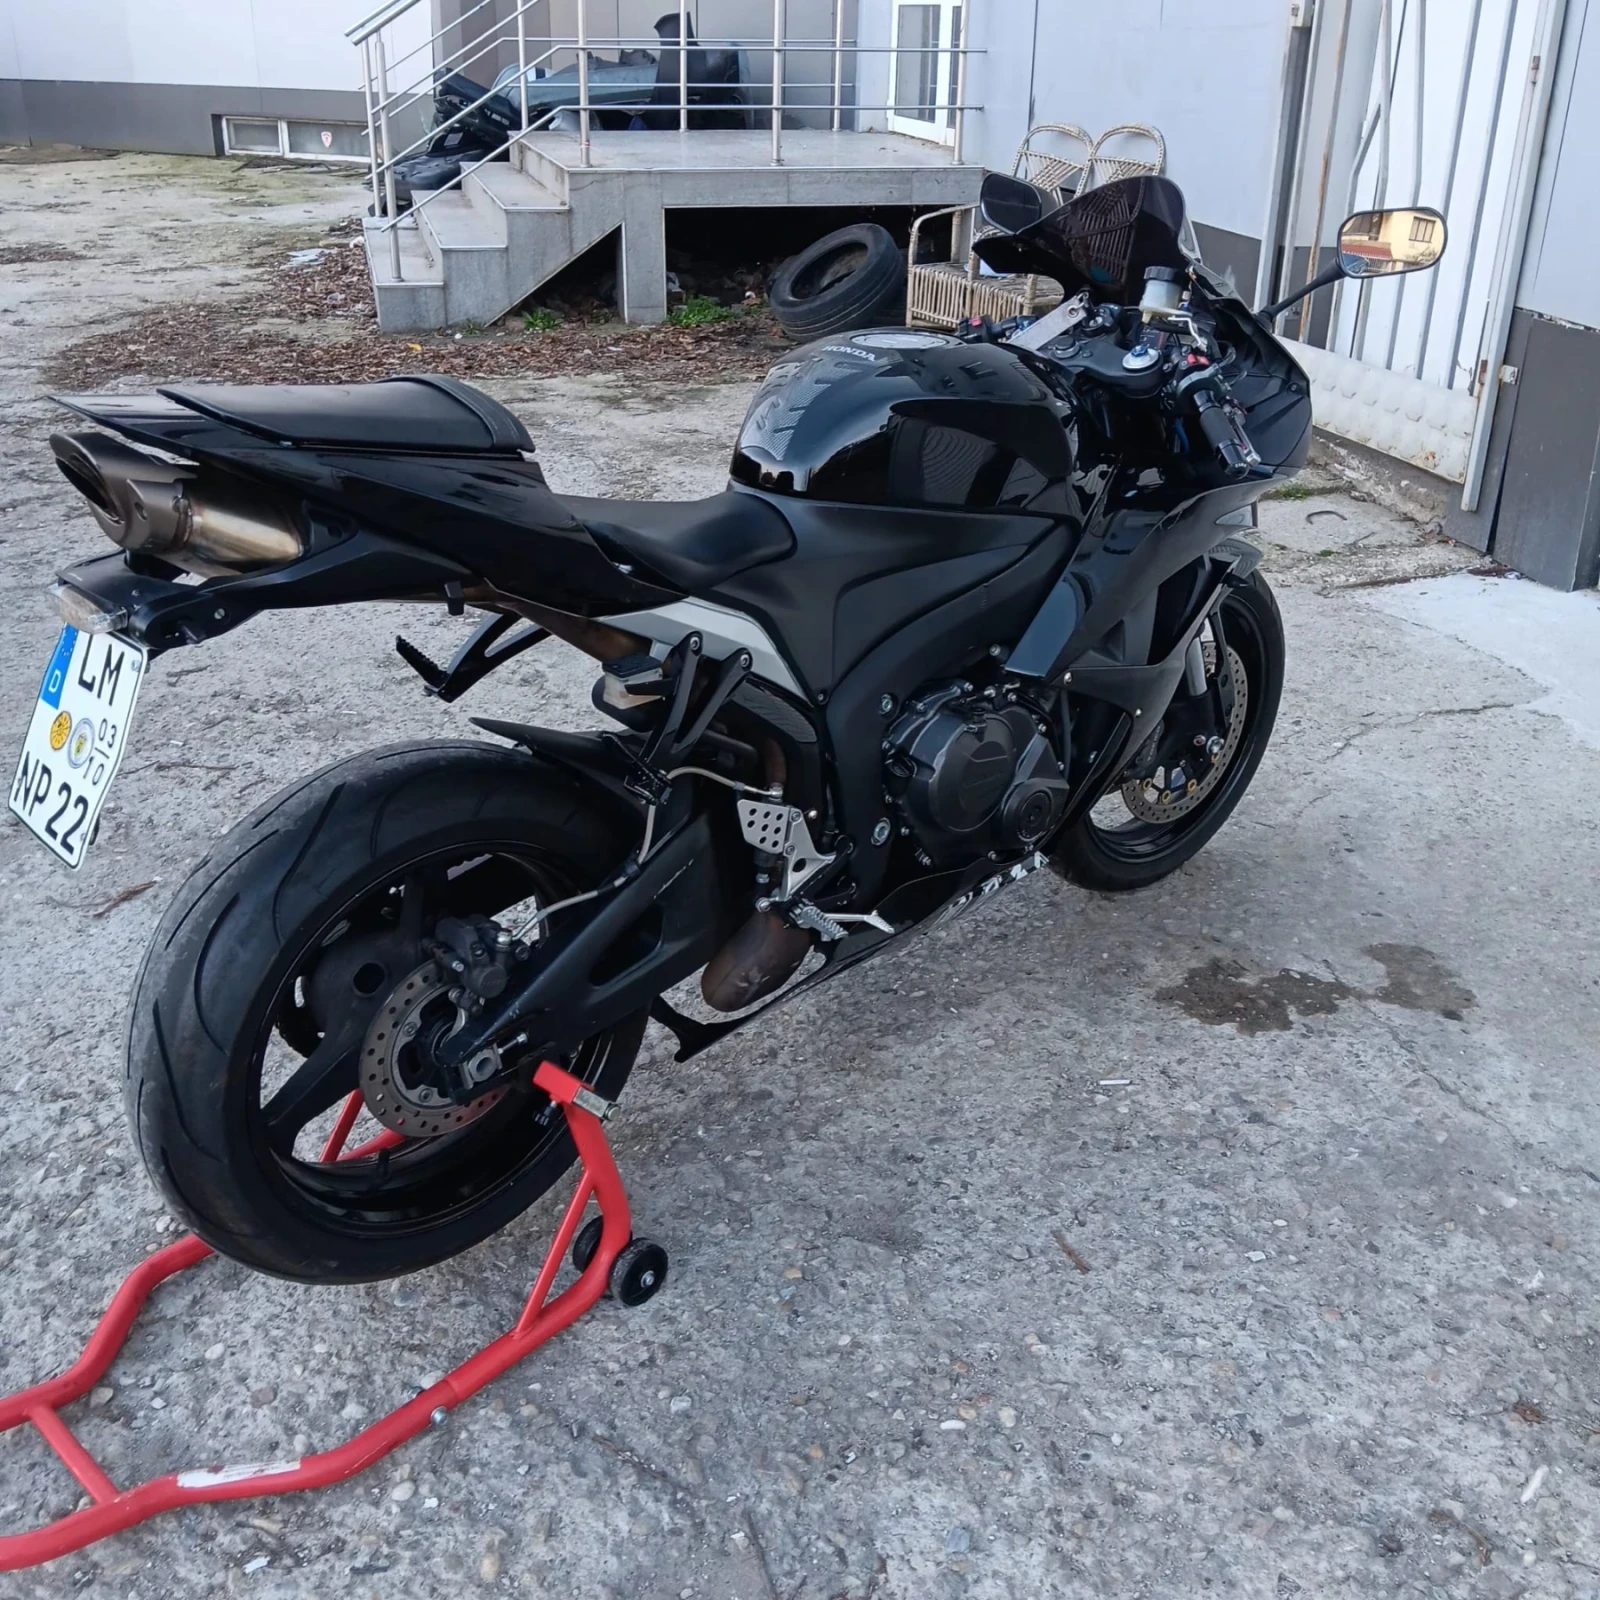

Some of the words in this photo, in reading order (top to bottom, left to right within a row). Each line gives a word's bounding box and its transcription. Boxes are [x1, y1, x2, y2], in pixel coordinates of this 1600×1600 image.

[821, 345, 876, 362] HONDA
[49, 669, 62, 693] D
[78, 634, 125, 707] LM
[98, 718, 117, 749] 03
[83, 756, 105, 786] 10
[14, 751, 52, 817] NP
[45, 781, 89, 856] 22
